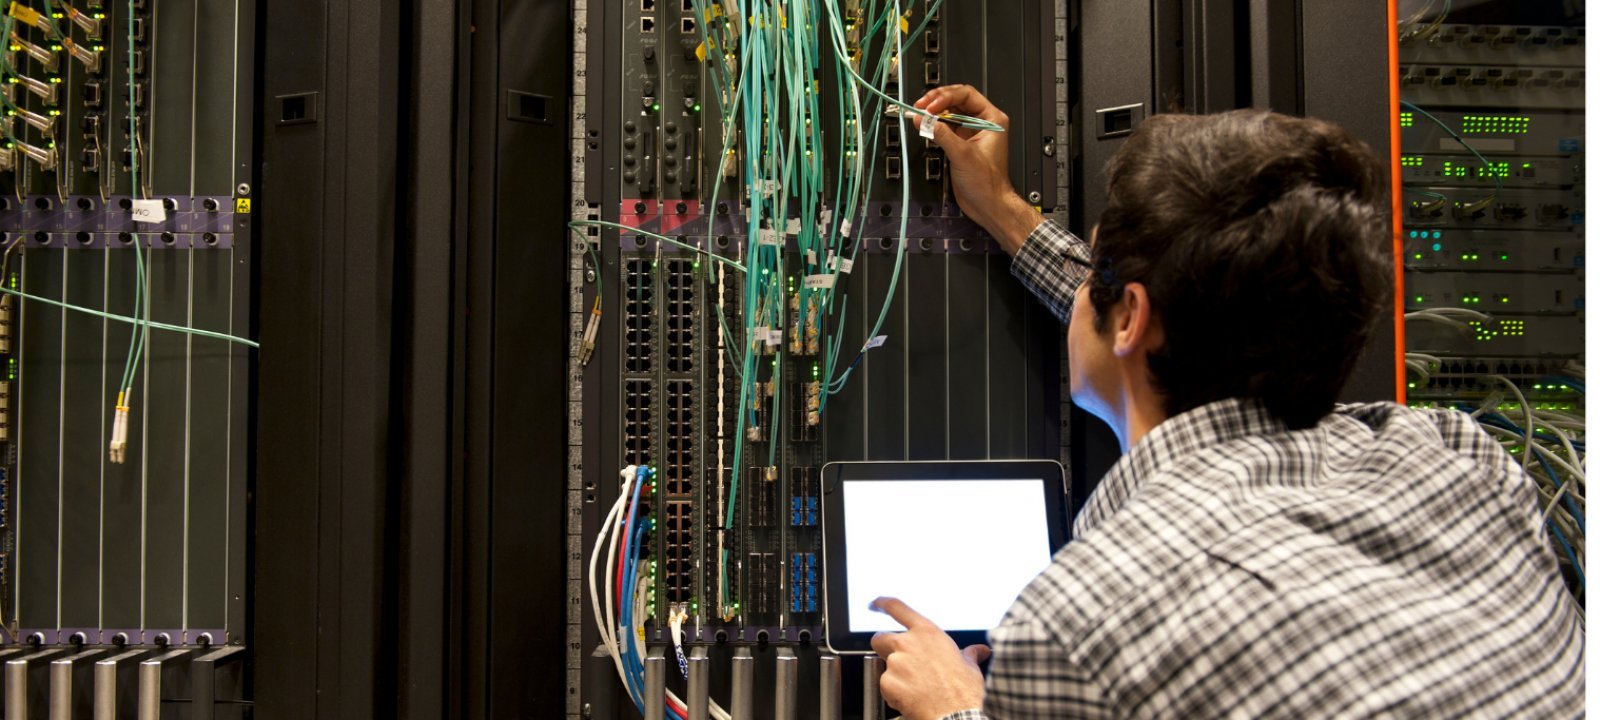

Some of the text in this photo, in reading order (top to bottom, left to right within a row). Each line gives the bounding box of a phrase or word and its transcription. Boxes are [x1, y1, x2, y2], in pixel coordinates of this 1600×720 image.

[577, 70, 586, 78] 23
[575, 199, 585, 207] 20
[575, 286, 584, 294] 18
[573, 374, 583, 382] 16
[573, 419, 582, 427] 15
[572, 463, 582, 471] 14
[572, 508, 581, 516] 13
[572, 553, 581, 561] 12
[571, 597, 580, 605] 11
[571, 642, 580, 650] 10
[569, 687, 575, 695] 9
